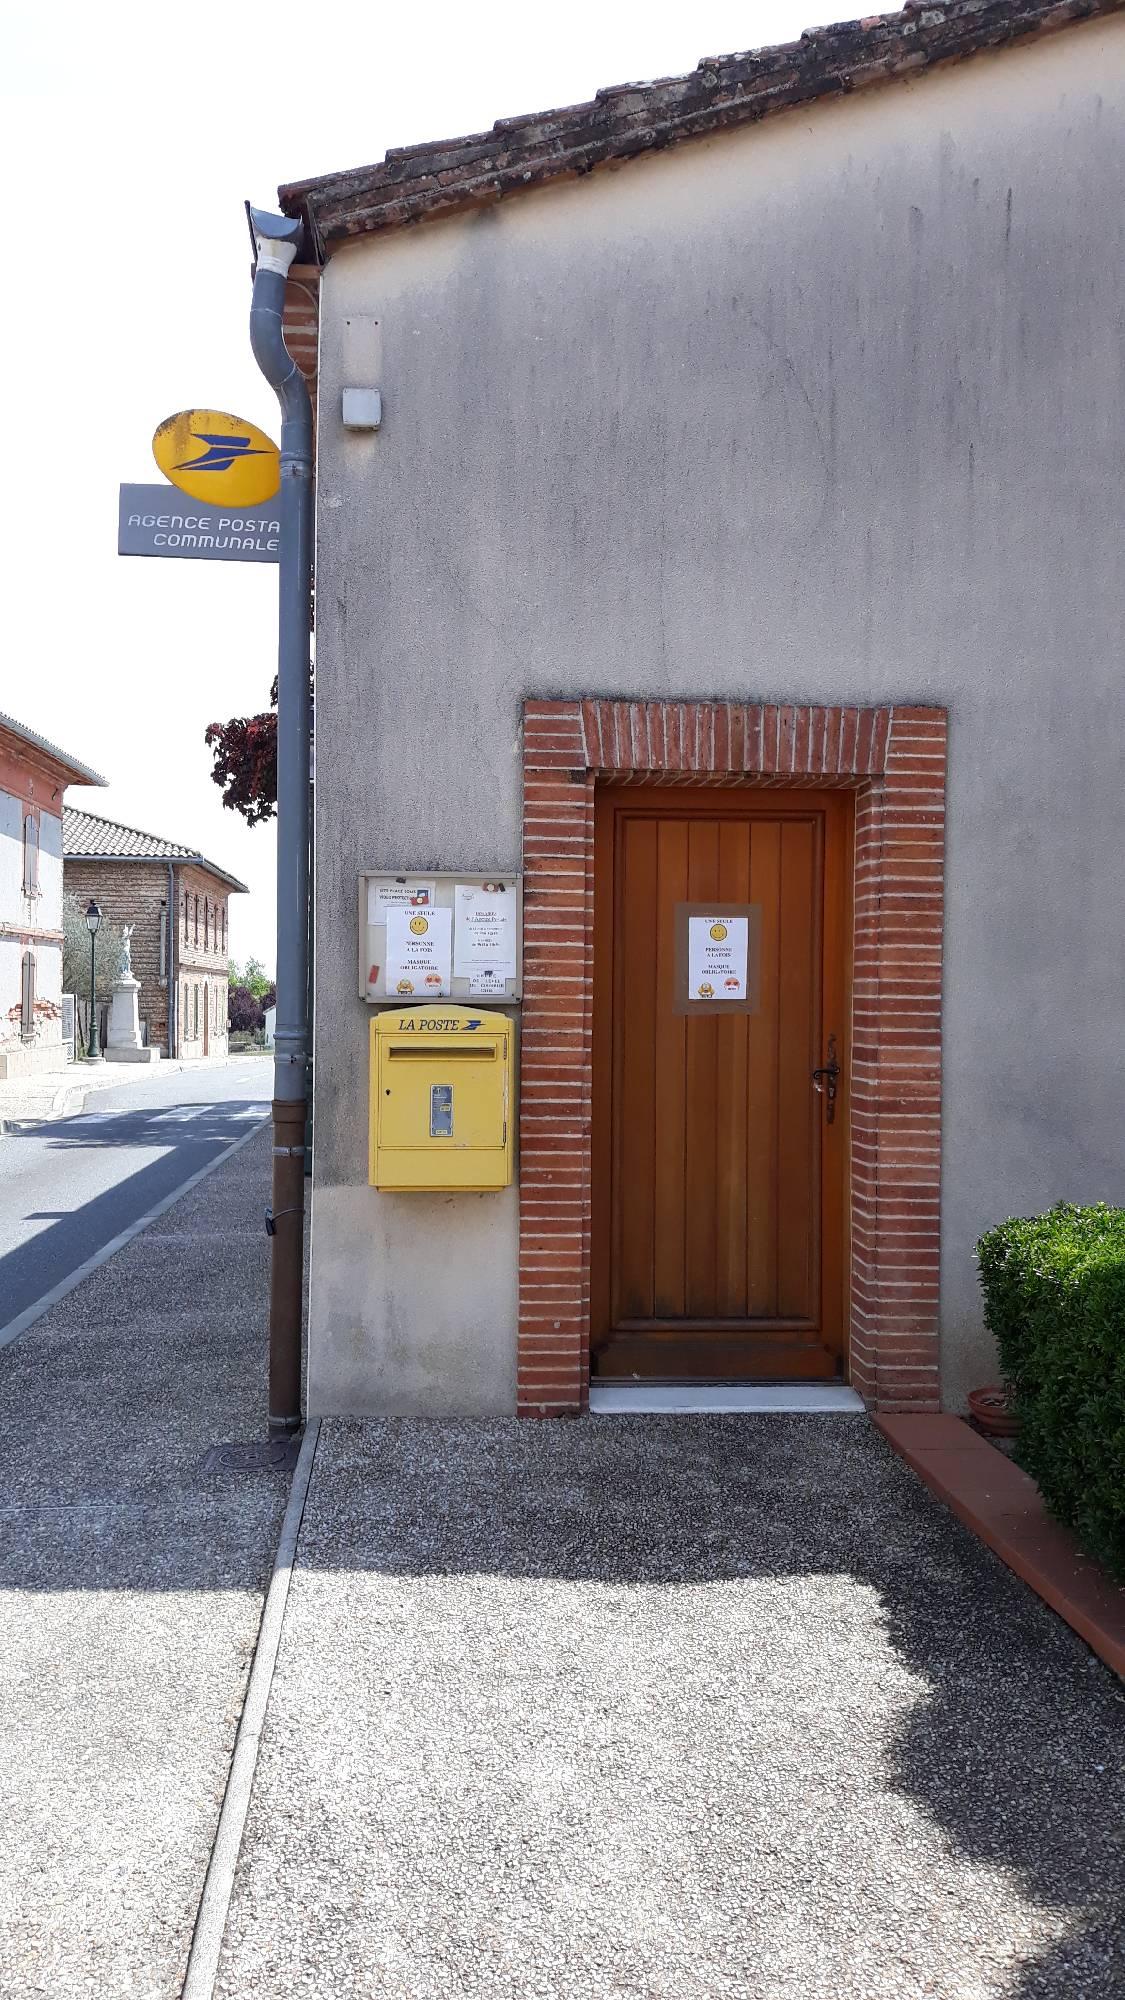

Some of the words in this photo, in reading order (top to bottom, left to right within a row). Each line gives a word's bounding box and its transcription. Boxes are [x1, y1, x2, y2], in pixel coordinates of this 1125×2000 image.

[127, 514, 212, 530] AGENCE
[218, 518, 280, 533] POSTA
[153, 533, 280, 551] COMMUNALE
[398, 1019, 416, 1031] LA
[418, 1019, 460, 1031] POSTE
